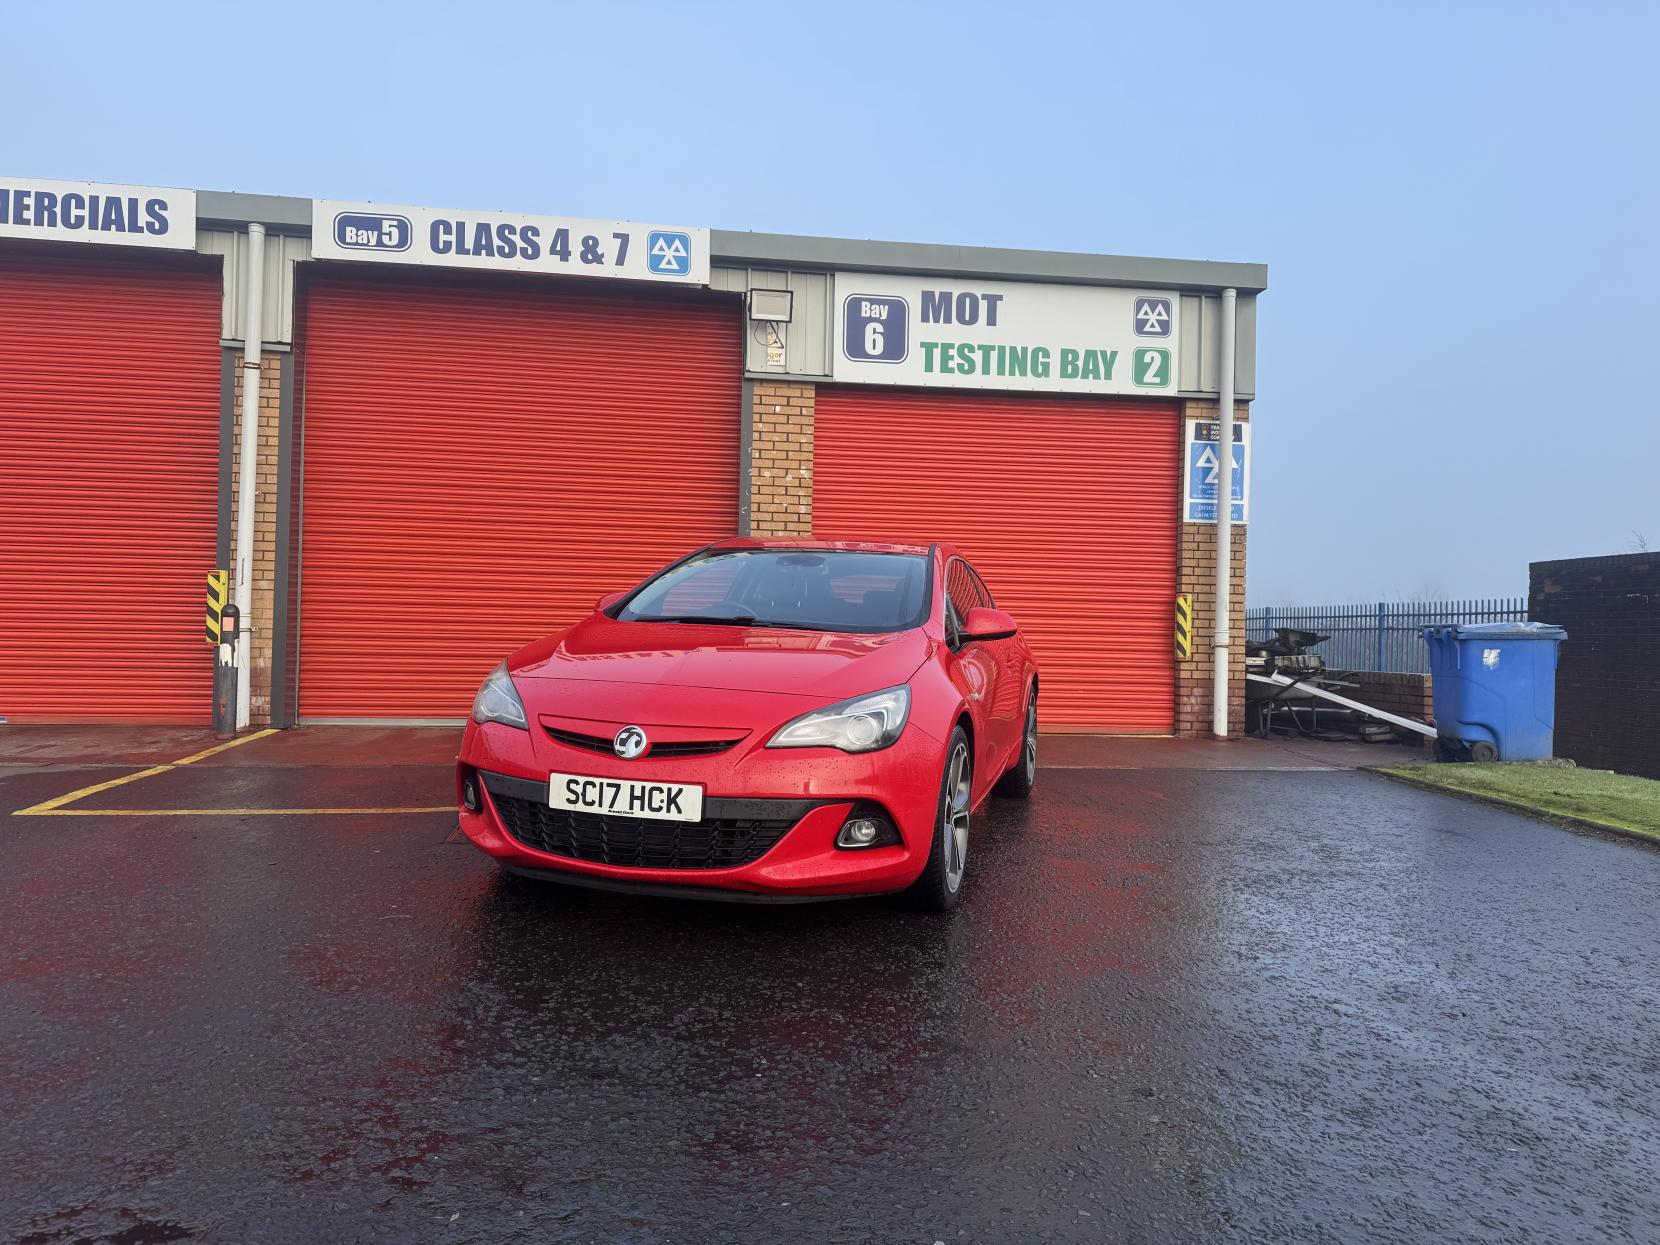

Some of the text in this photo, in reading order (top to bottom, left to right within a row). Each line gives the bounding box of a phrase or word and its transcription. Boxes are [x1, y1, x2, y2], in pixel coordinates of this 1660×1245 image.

[345, 219, 399, 246] Bay 5
[430, 219, 630, 266] CLASS 4 & 7
[861, 301, 888, 320] Bay
[920, 290, 1004, 327] MOT
[864, 322, 884, 356] 6
[920, 341, 1162, 383] TESTING BAY 2
[565, 778, 684, 814] SC17 HCK
